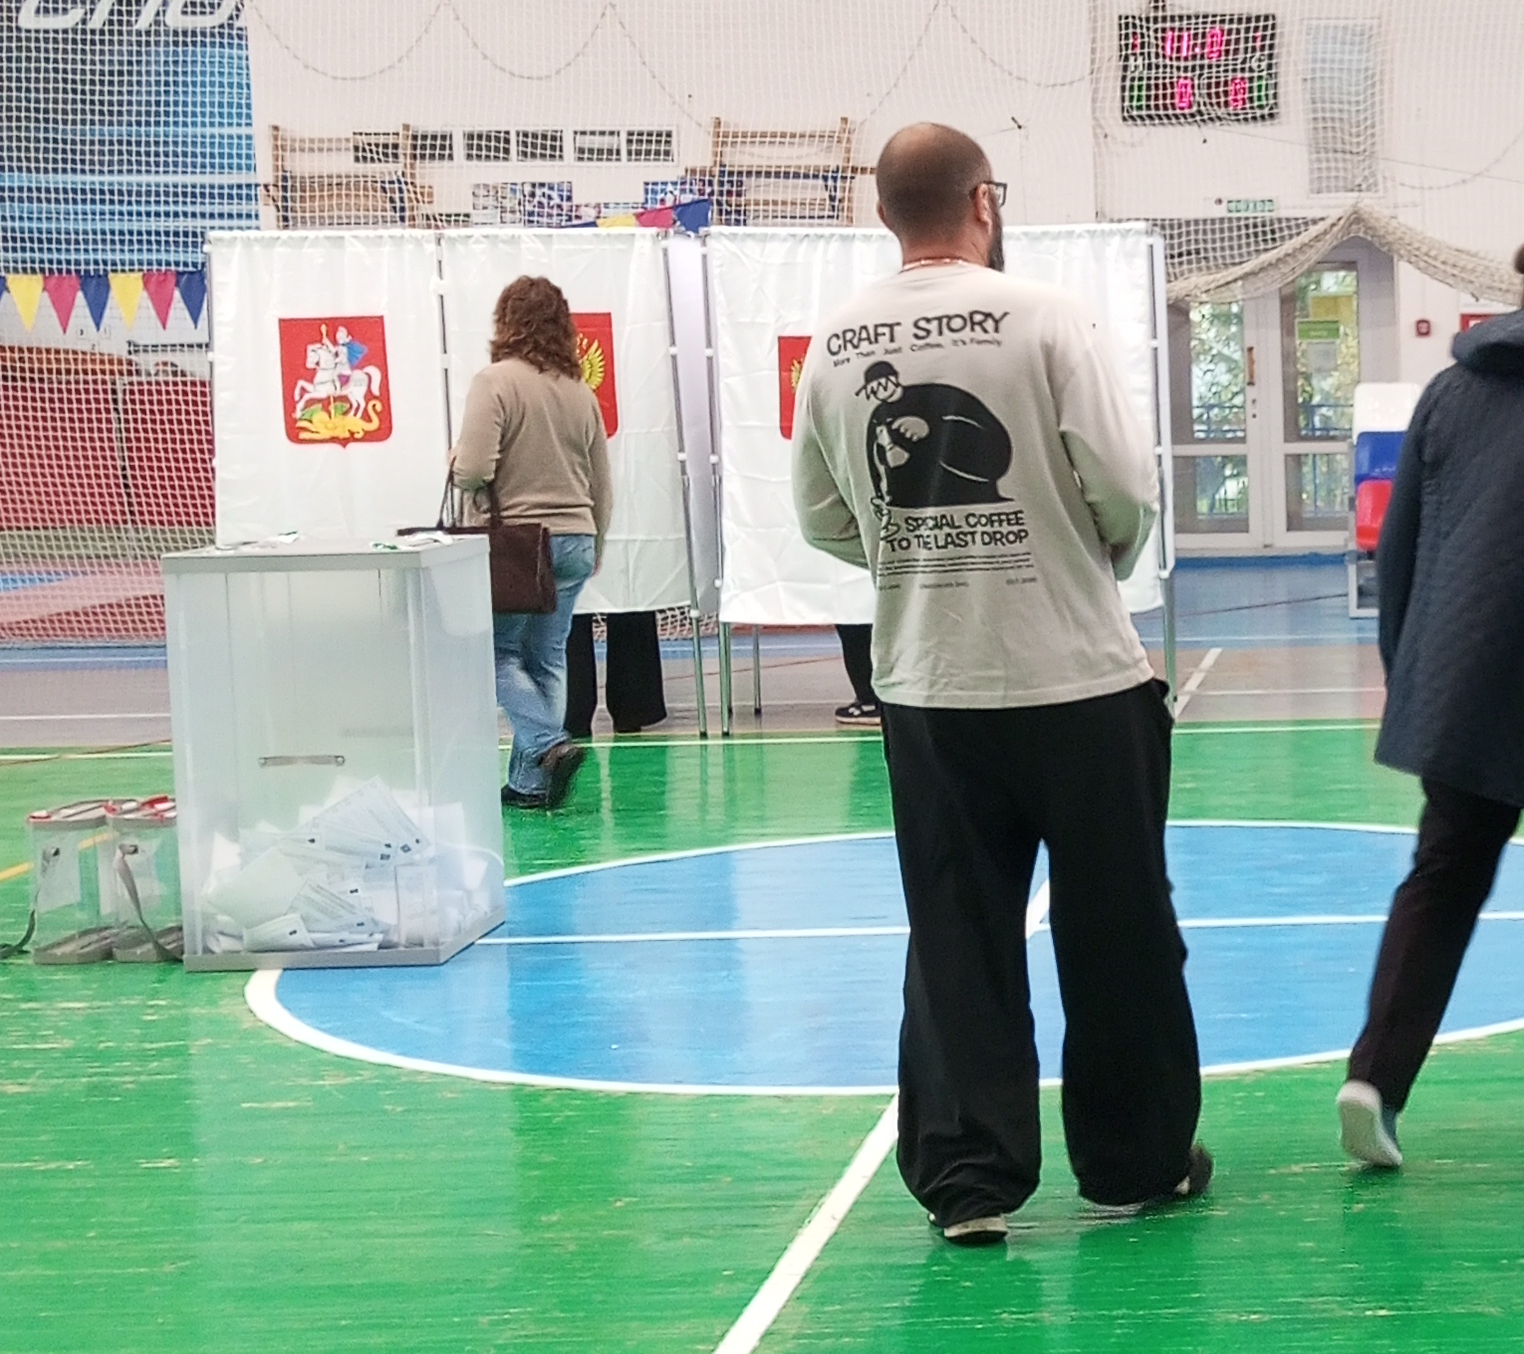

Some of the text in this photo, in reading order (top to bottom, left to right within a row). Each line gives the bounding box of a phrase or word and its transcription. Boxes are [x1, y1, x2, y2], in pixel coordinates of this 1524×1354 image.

[826, 310, 1011, 357] CRAFT STORY
[964, 509, 1025, 529] COFFEE
[886, 536, 911, 552] TO
[934, 530, 978, 550] LAST
[980, 528, 1029, 547] DROP
